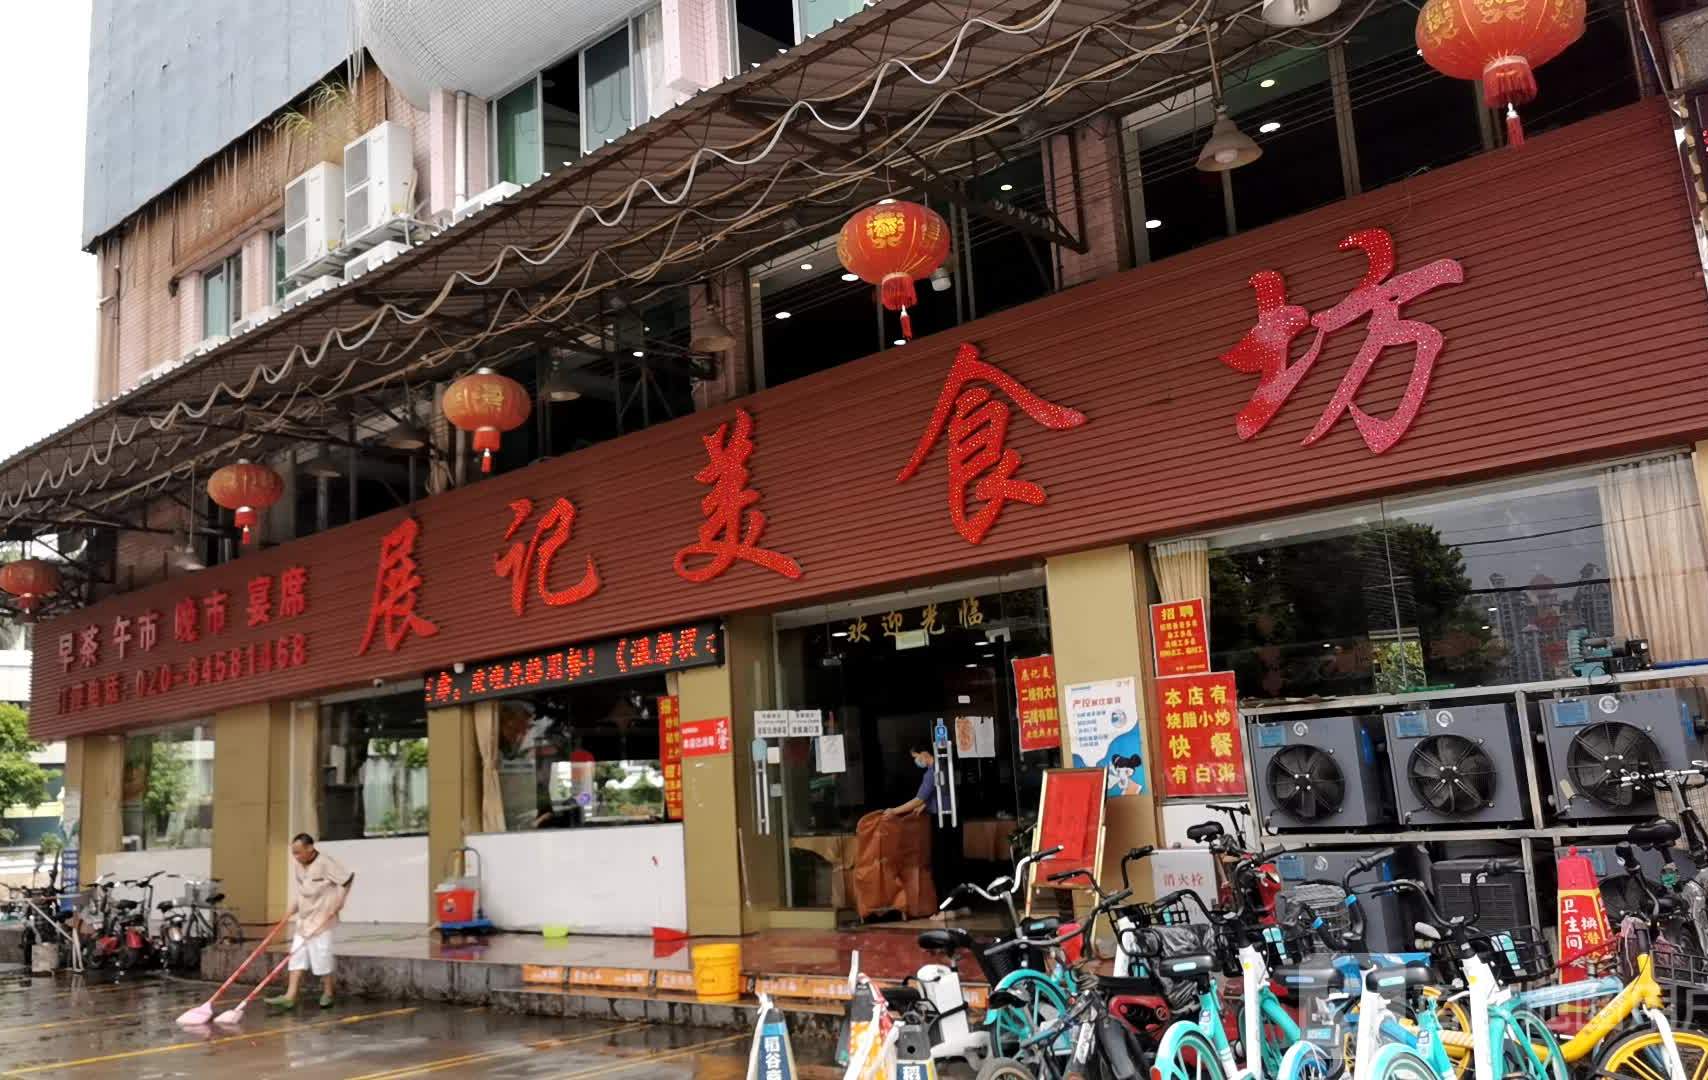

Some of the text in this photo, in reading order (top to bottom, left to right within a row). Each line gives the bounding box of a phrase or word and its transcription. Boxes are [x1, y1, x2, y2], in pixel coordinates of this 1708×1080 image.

[359, 228, 1465, 654] 展记美食坊
[58, 624, 100, 672] 早茶
[113, 612, 158, 660] 午市
[247, 567, 306, 626] 宴席
[847, 597, 985, 643] 欢迎光临
[1160, 604, 1195, 621] 招聘
[1164, 684, 1228, 709] 本店有
[1165, 709, 1232, 730] 烧腊小炒
[1171, 762, 1237, 785] 有白粥
[1163, 871, 1204, 888] 消火栓
[1561, 898, 1584, 950] 卫生间
